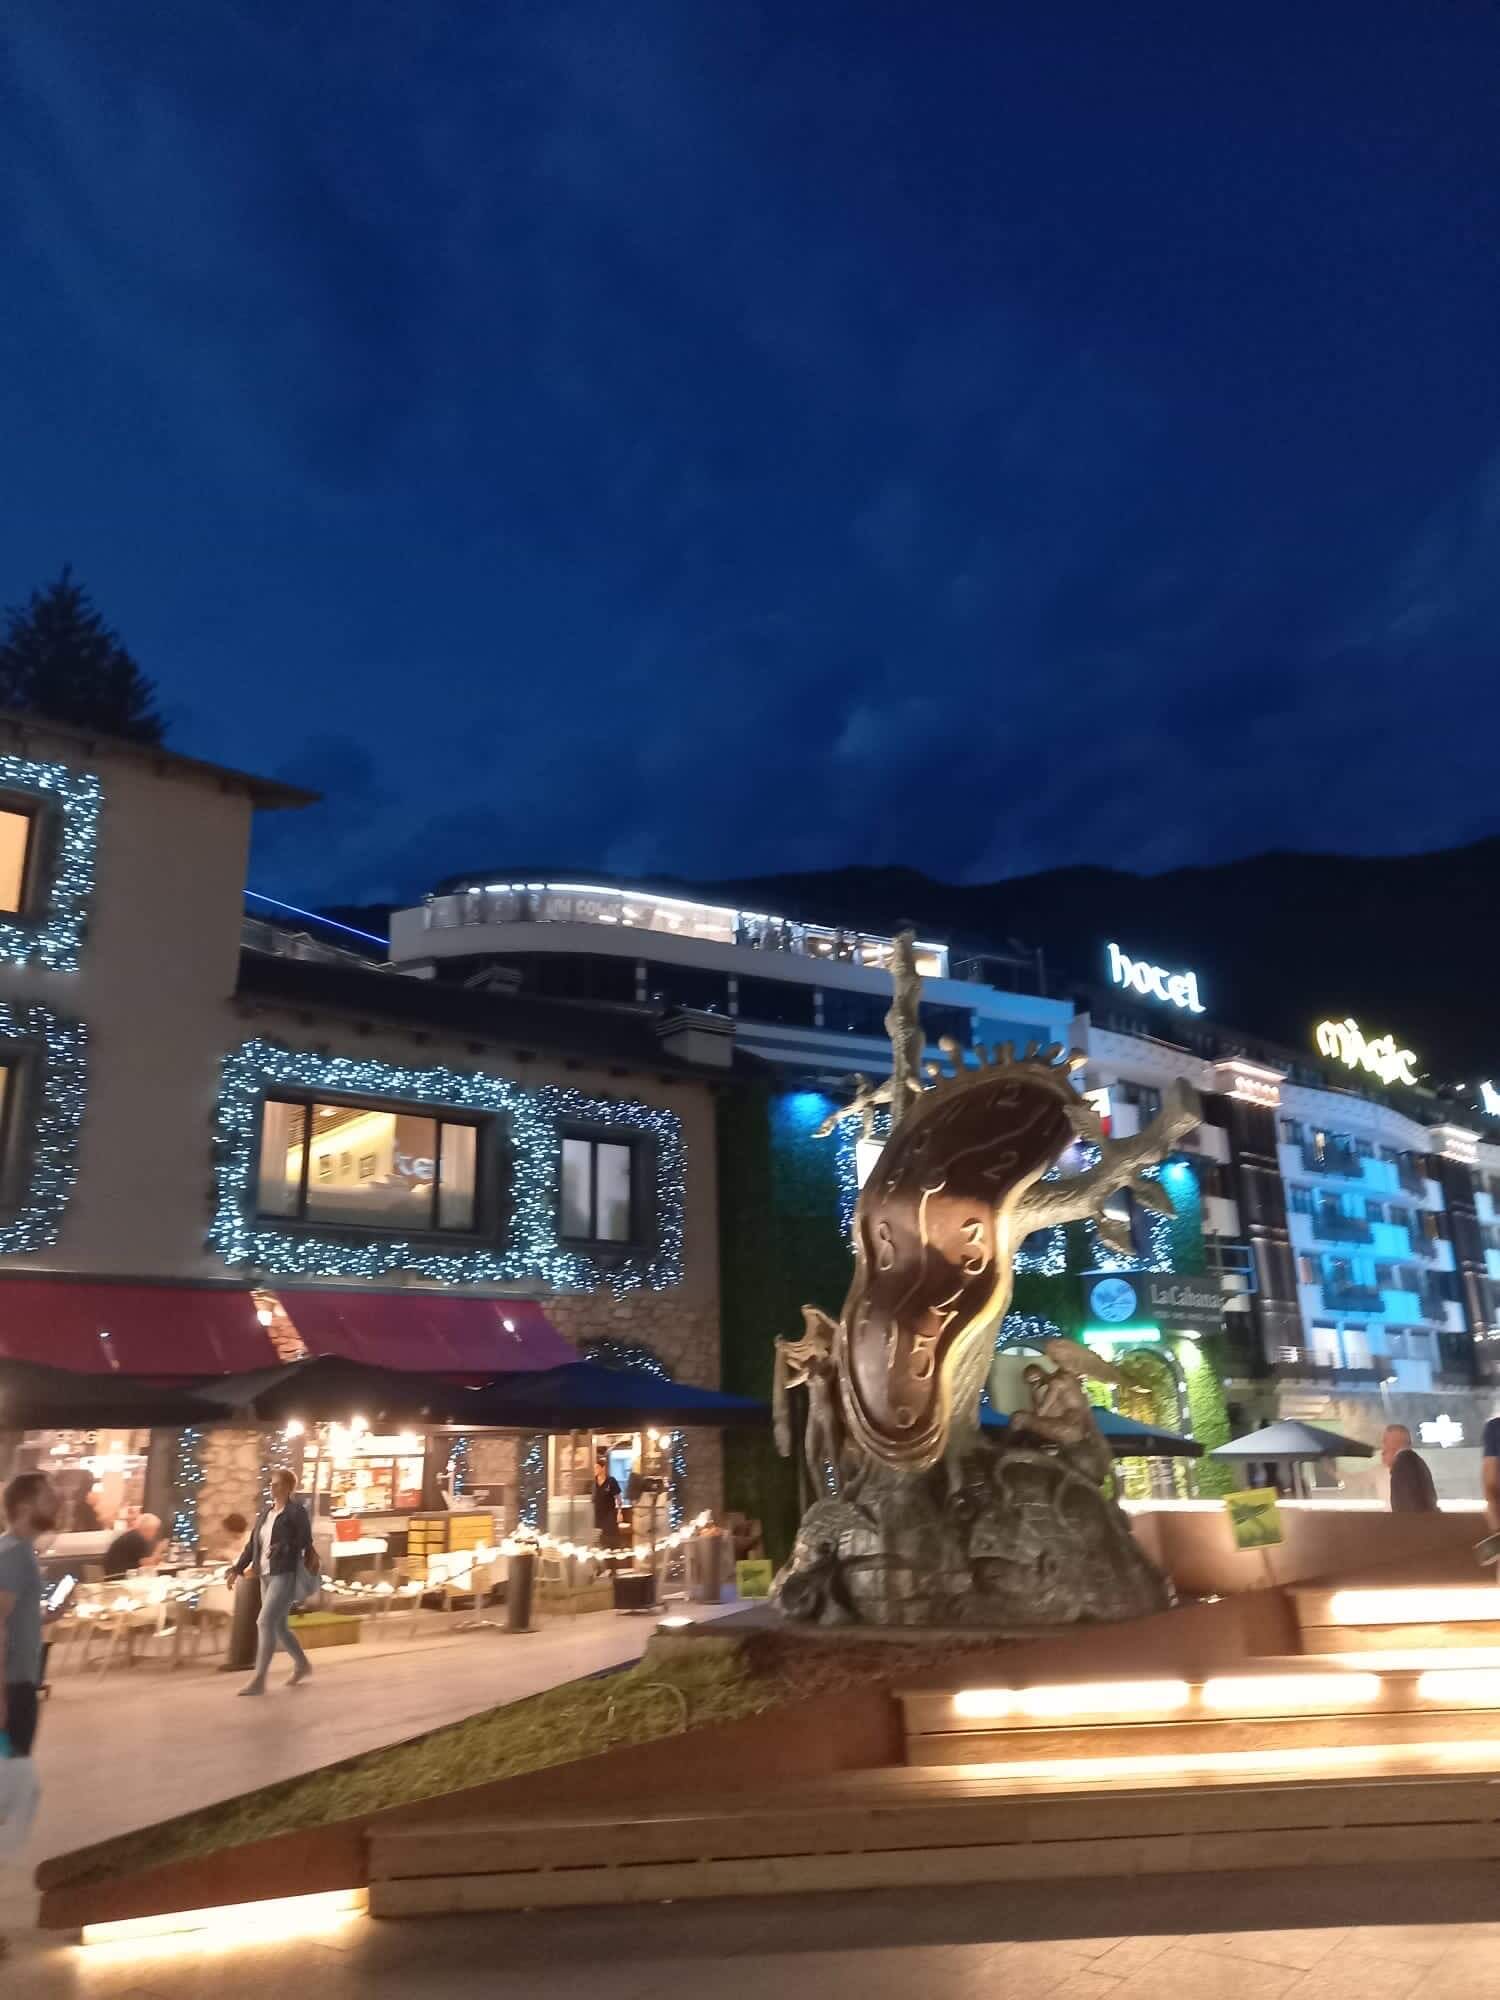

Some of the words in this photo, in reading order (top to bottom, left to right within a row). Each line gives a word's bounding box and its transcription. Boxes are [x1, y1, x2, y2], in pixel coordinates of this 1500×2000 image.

[1107, 942, 1207, 1014] hotel
[960, 1217, 990, 1276] 3
[908, 1333, 937, 1382] 5
